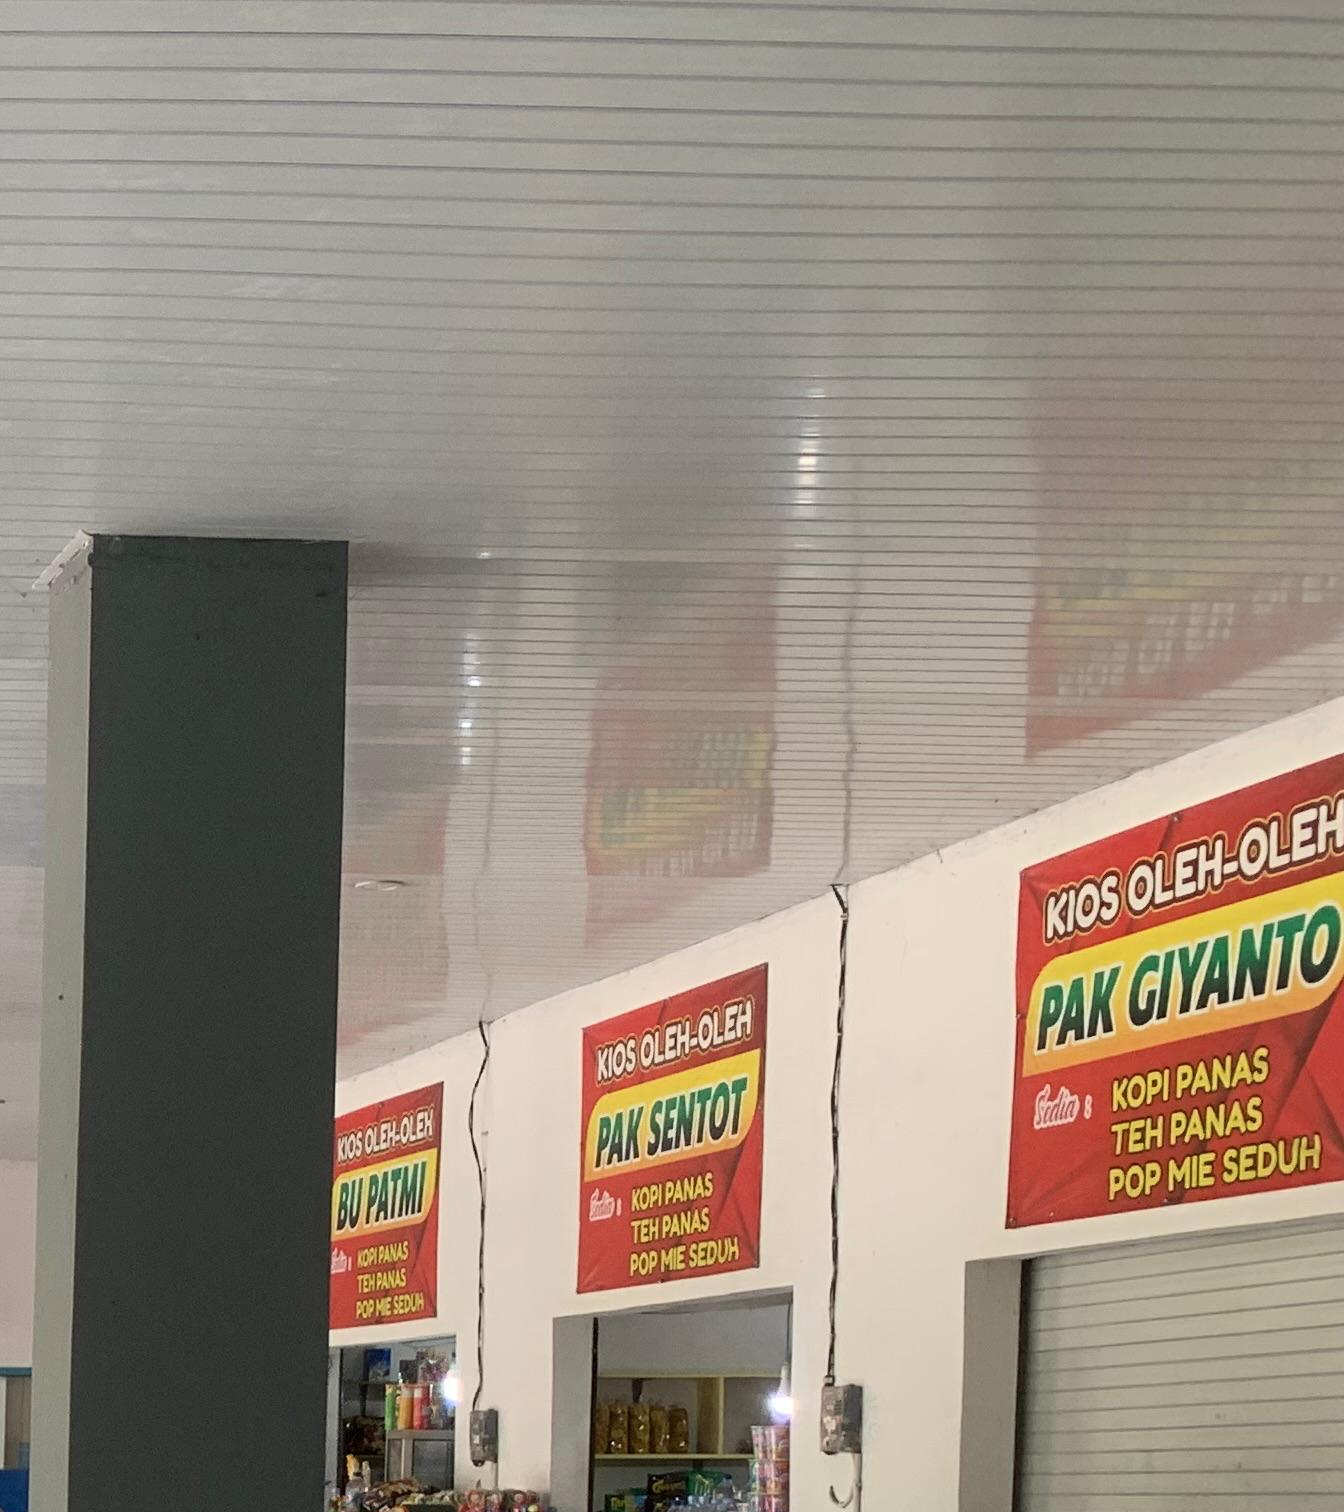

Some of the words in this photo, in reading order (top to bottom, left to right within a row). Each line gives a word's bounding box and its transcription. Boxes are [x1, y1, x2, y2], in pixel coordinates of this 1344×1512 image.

[1045, 878, 1118, 939] KIOS
[1128, 803, 1344, 914] OLEH-OLEH
[1035, 966, 1121, 1052] PAK
[1128, 905, 1342, 1028] GIYANTO
[597, 1038, 637, 1082] KIOS
[640, 1000, 753, 1069] OLEH-OLEH
[1112, 1069, 1170, 1113] KOPI
[1176, 1047, 1269, 1097] PANAS
[337, 1130, 363, 1161] KIOS
[364, 1108, 433, 1155] OLEH-OLEH
[594, 1106, 644, 1169] PAK
[647, 1076, 748, 1156] SENTOT
[1111, 1115, 1163, 1157] TEH
[1169, 1097, 1264, 1147] PANAS
[336, 1177, 364, 1231] BU
[365, 1161, 427, 1225] PATMI
[631, 1185, 663, 1212] KOPI
[665, 1172, 713, 1206] PANAS
[1108, 1158, 1162, 1202] POP
[1172, 1151, 1216, 1191] MIE
[1221, 1132, 1322, 1185] SEDUH
[357, 1247, 378, 1268] KOPI
[378, 1241, 409, 1264] PANAS
[630, 1216, 659, 1244] TEH
[662, 1207, 710, 1239] PANAS
[356, 1273, 375, 1293] TEH
[376, 1267, 407, 1290] PANAS
[629, 1251, 658, 1277] POP
[661, 1245, 686, 1273] MIE
[688, 1236, 740, 1268] SEDUH
[356, 1299, 374, 1319] POP
[376, 1296, 392, 1316] MIE
[393, 1292, 424, 1314] SEDUH
